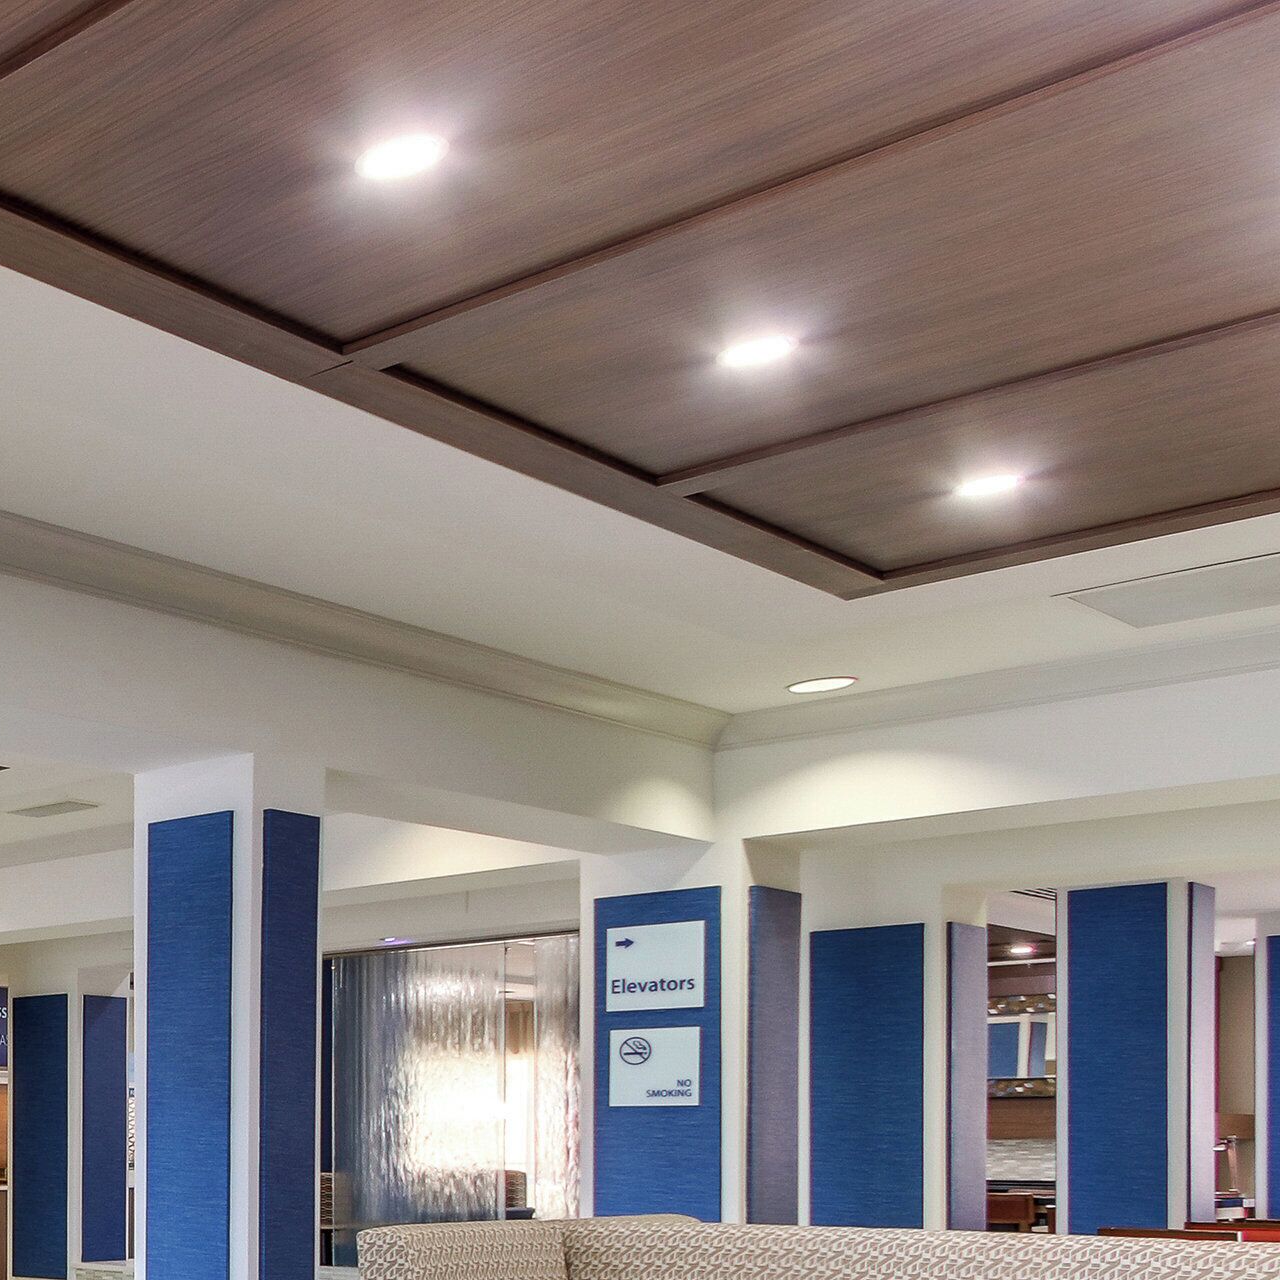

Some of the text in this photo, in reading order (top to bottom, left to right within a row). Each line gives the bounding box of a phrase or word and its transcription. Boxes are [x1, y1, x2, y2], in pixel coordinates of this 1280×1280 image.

[611, 977, 695, 995] Elevators
[676, 1079, 692, 1088] NO
[646, 1089, 692, 1098] SMOKING
